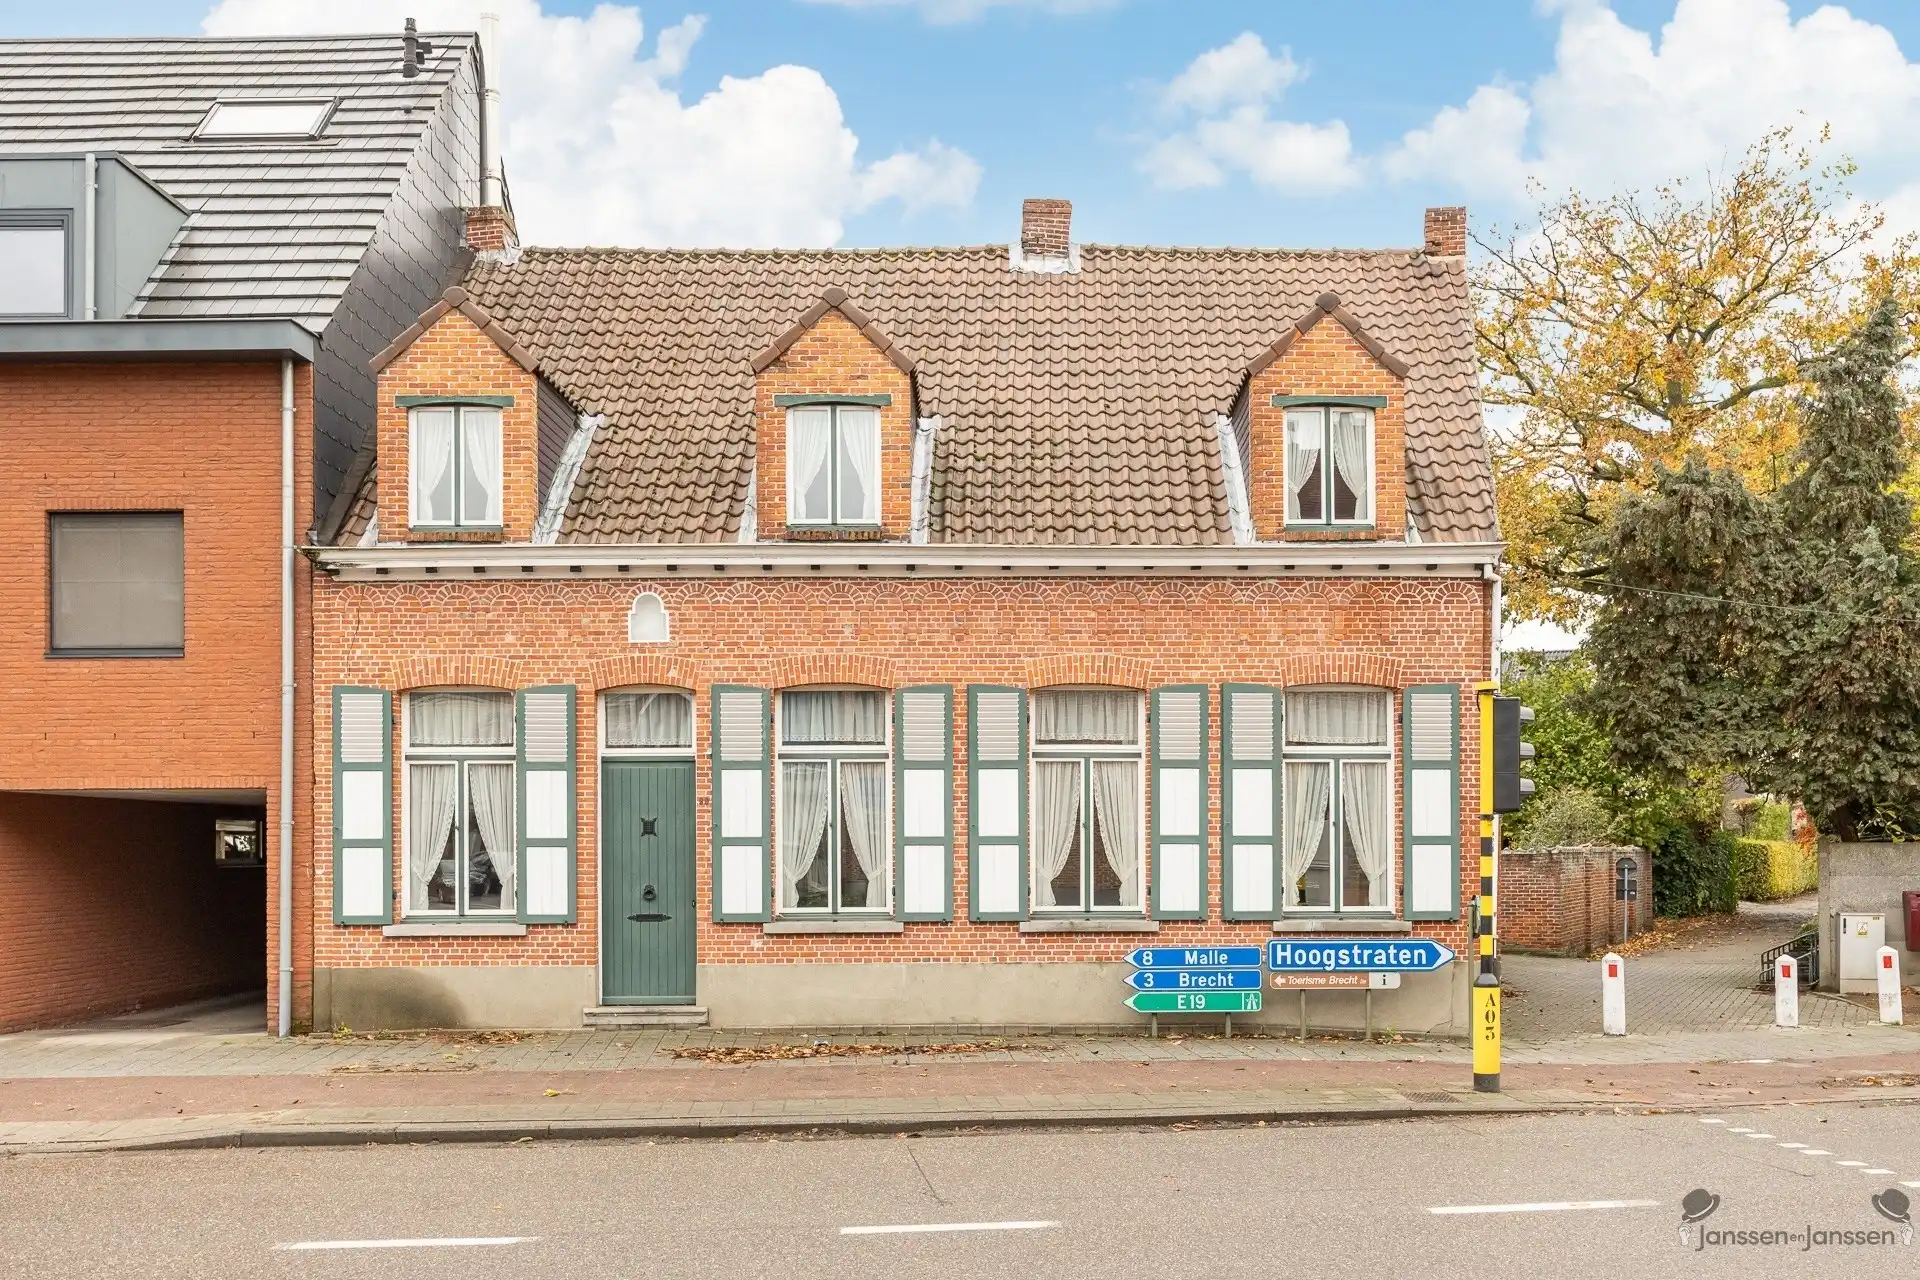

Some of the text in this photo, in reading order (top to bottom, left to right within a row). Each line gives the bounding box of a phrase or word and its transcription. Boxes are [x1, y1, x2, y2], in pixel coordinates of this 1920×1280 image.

[1142, 950, 1228, 965] 8 Malle
[1276, 944, 1427, 971] Hoogstraten
[1143, 972, 1234, 987] 3 Brecht
[1287, 975, 1326, 985] Toerisme
[1328, 975, 1359, 985] Brecht
